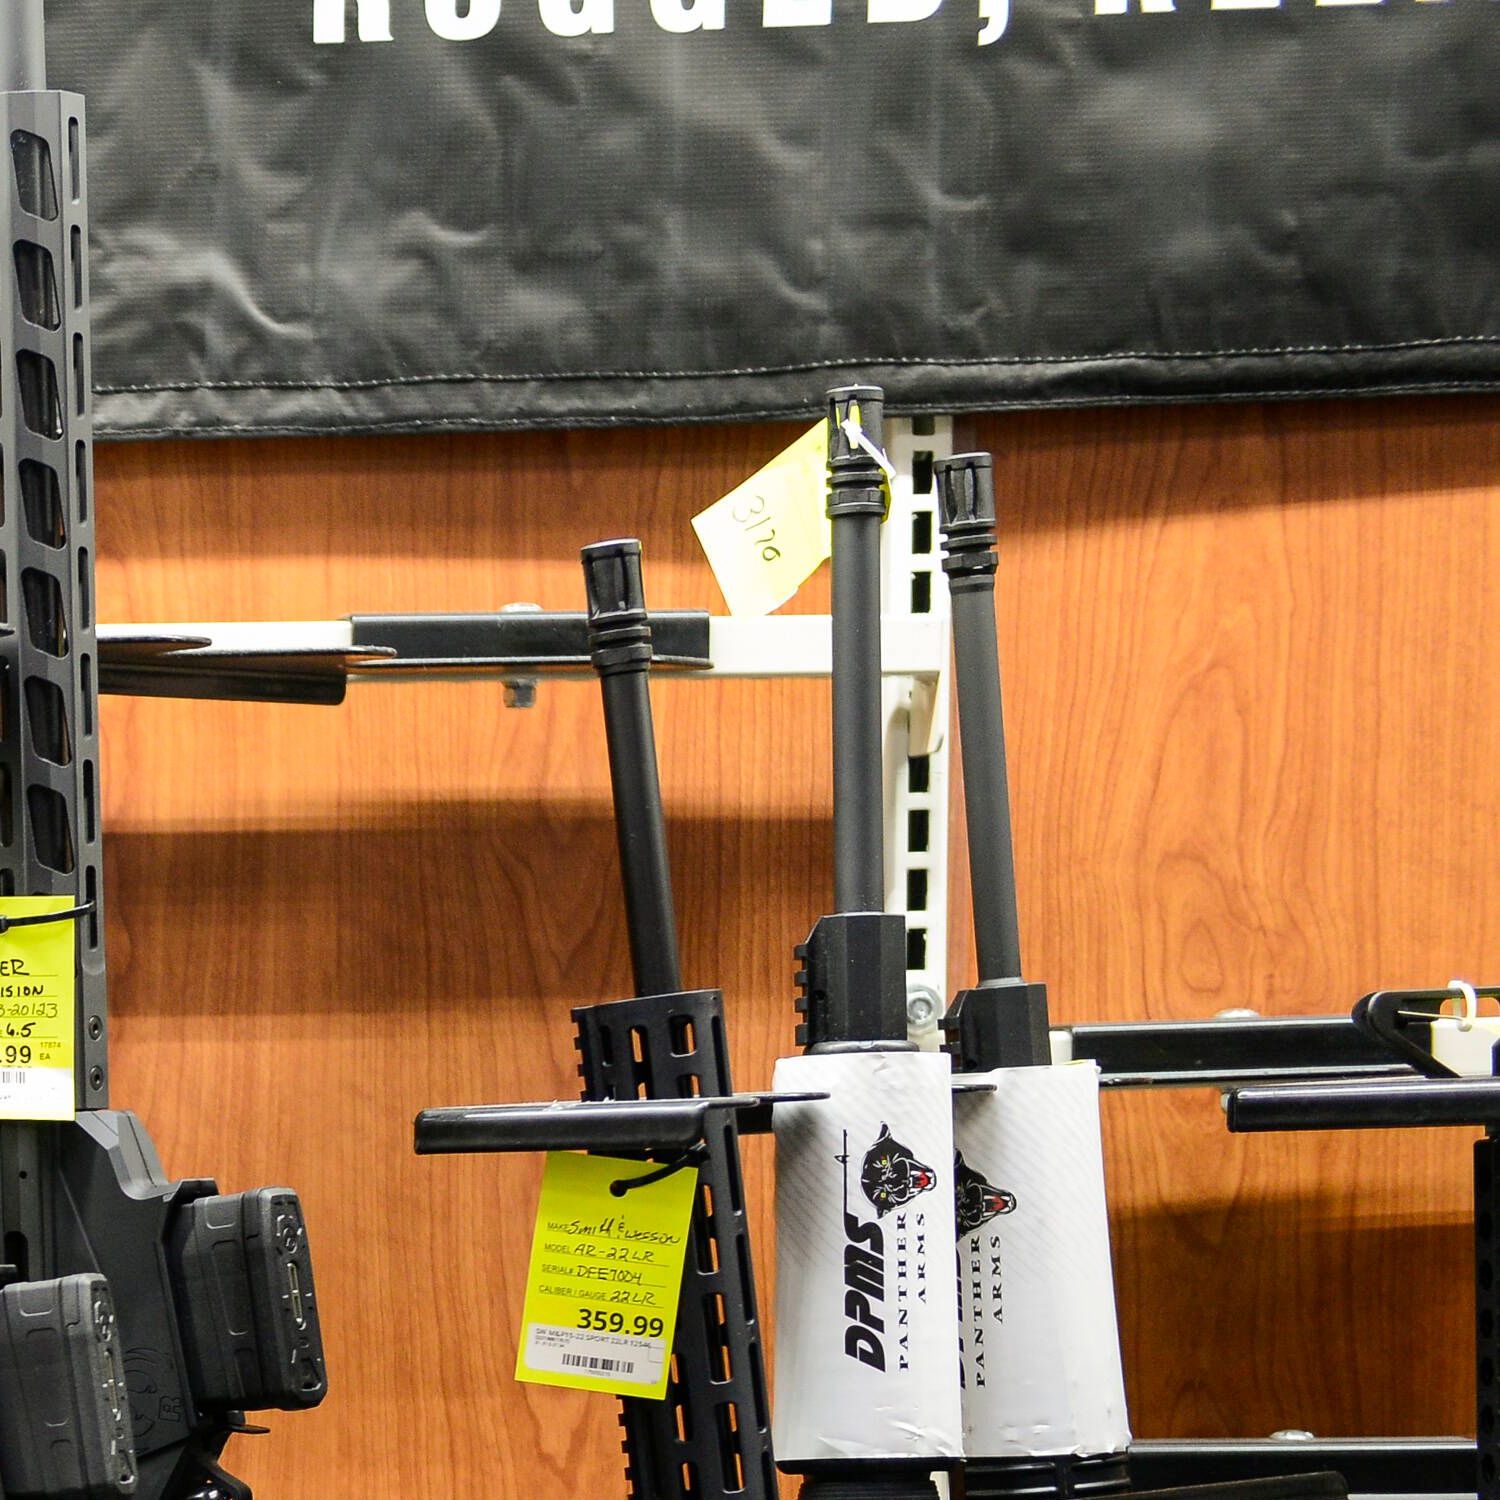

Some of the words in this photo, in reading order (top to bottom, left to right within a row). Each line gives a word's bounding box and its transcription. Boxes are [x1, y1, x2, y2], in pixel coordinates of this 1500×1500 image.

[544, 1243, 571, 1255] MODEL
[547, 1222, 568, 1232] MAKE
[916, 1212, 928, 1304] ARMS
[539, 1284, 573, 1296] CALIBER
[578, 1289, 606, 1300] GAUGE
[577, 1308, 664, 1338] 359.99
[844, 1211, 886, 1372] DPMS
[897, 1212, 909, 1370] PANTHER
[971, 1235, 986, 1388] PANTHER
[990, 1235, 1003, 1324] ARMS
